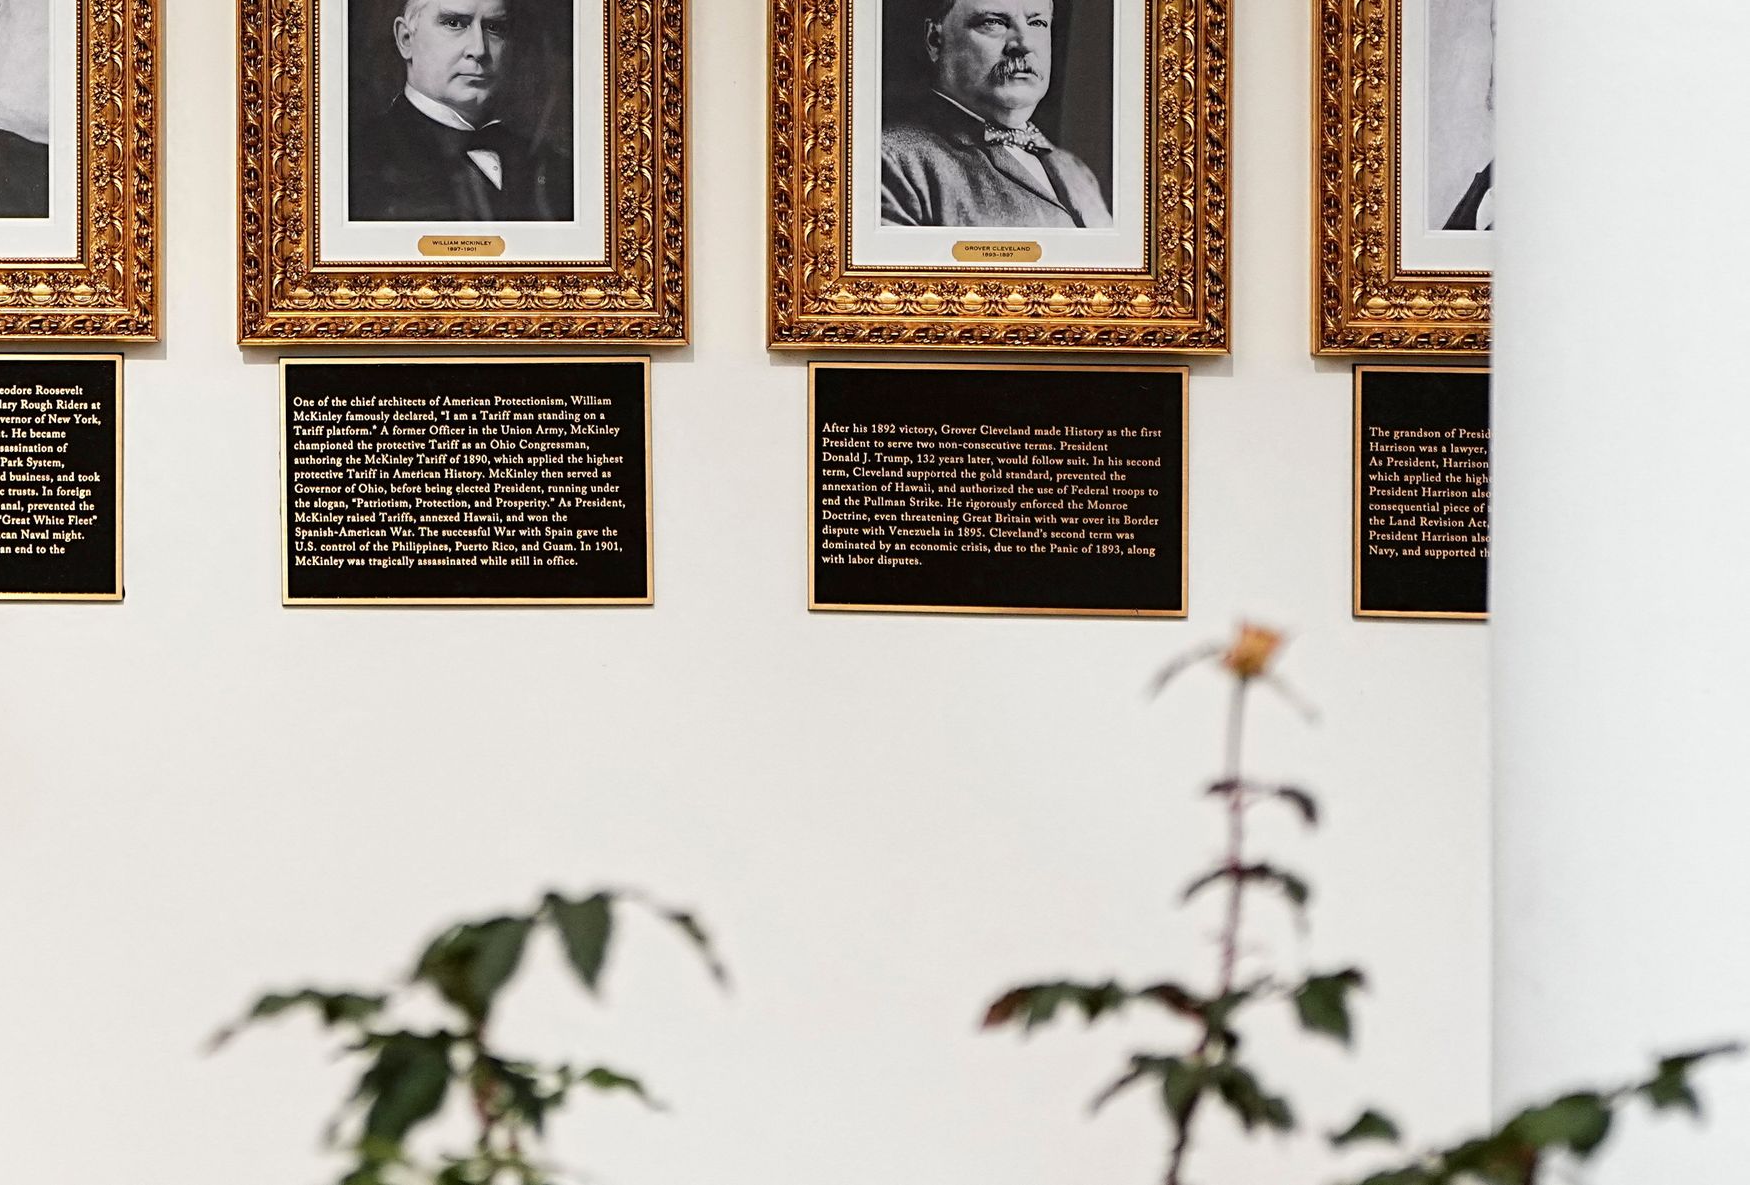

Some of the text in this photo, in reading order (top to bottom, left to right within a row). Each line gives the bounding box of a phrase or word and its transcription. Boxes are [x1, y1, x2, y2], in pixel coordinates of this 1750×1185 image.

[36, 385, 83, 395] Roosevelt
[20, 399, 53, 412] Rough
[56, 400, 88, 409] Riders
[293, 395, 612, 406] One of the chief architects of American Protectionism, William
[822, 422, 850, 432] After
[853, 423, 868, 433] his
[872, 424, 896, 433] 1892
[899, 425, 937, 436] victory,
[941, 424, 977, 434] Grover
[980, 425, 1030, 435] Cleveland
[1034, 426, 1061, 436] made
[1064, 426, 1104, 439] History
[1121, 427, 1137, 437] the
[1140, 427, 1162, 437] first
[1369, 427, 1390, 436] The
[1393, 428, 1441, 440] grandson
[1444, 428, 1457, 438] of
[822, 438, 870, 447] President
[1060, 442, 1108, 451] President
[1370, 442, 1415, 452] Harrison
[1451, 444, 1487, 456] lawyer,
[294, 453, 623, 467] authoring the McKinley Tariff of 1890, which applied the highest
[1369, 457, 1489, 468] As President, Harrison
[1369, 472, 1400, 481] which
[1404, 472, 1441, 484] applied
[1445, 473, 1462, 482] the
[1369, 486, 1492, 498] President Harrison also
[1369, 501, 1485, 515] consequential piece of
[1369, 516, 1385, 525] the
[1389, 516, 1416, 526] Land
[1420, 517, 1464, 526] Revision
[1369, 545, 1476, 559] Navy, and supported
